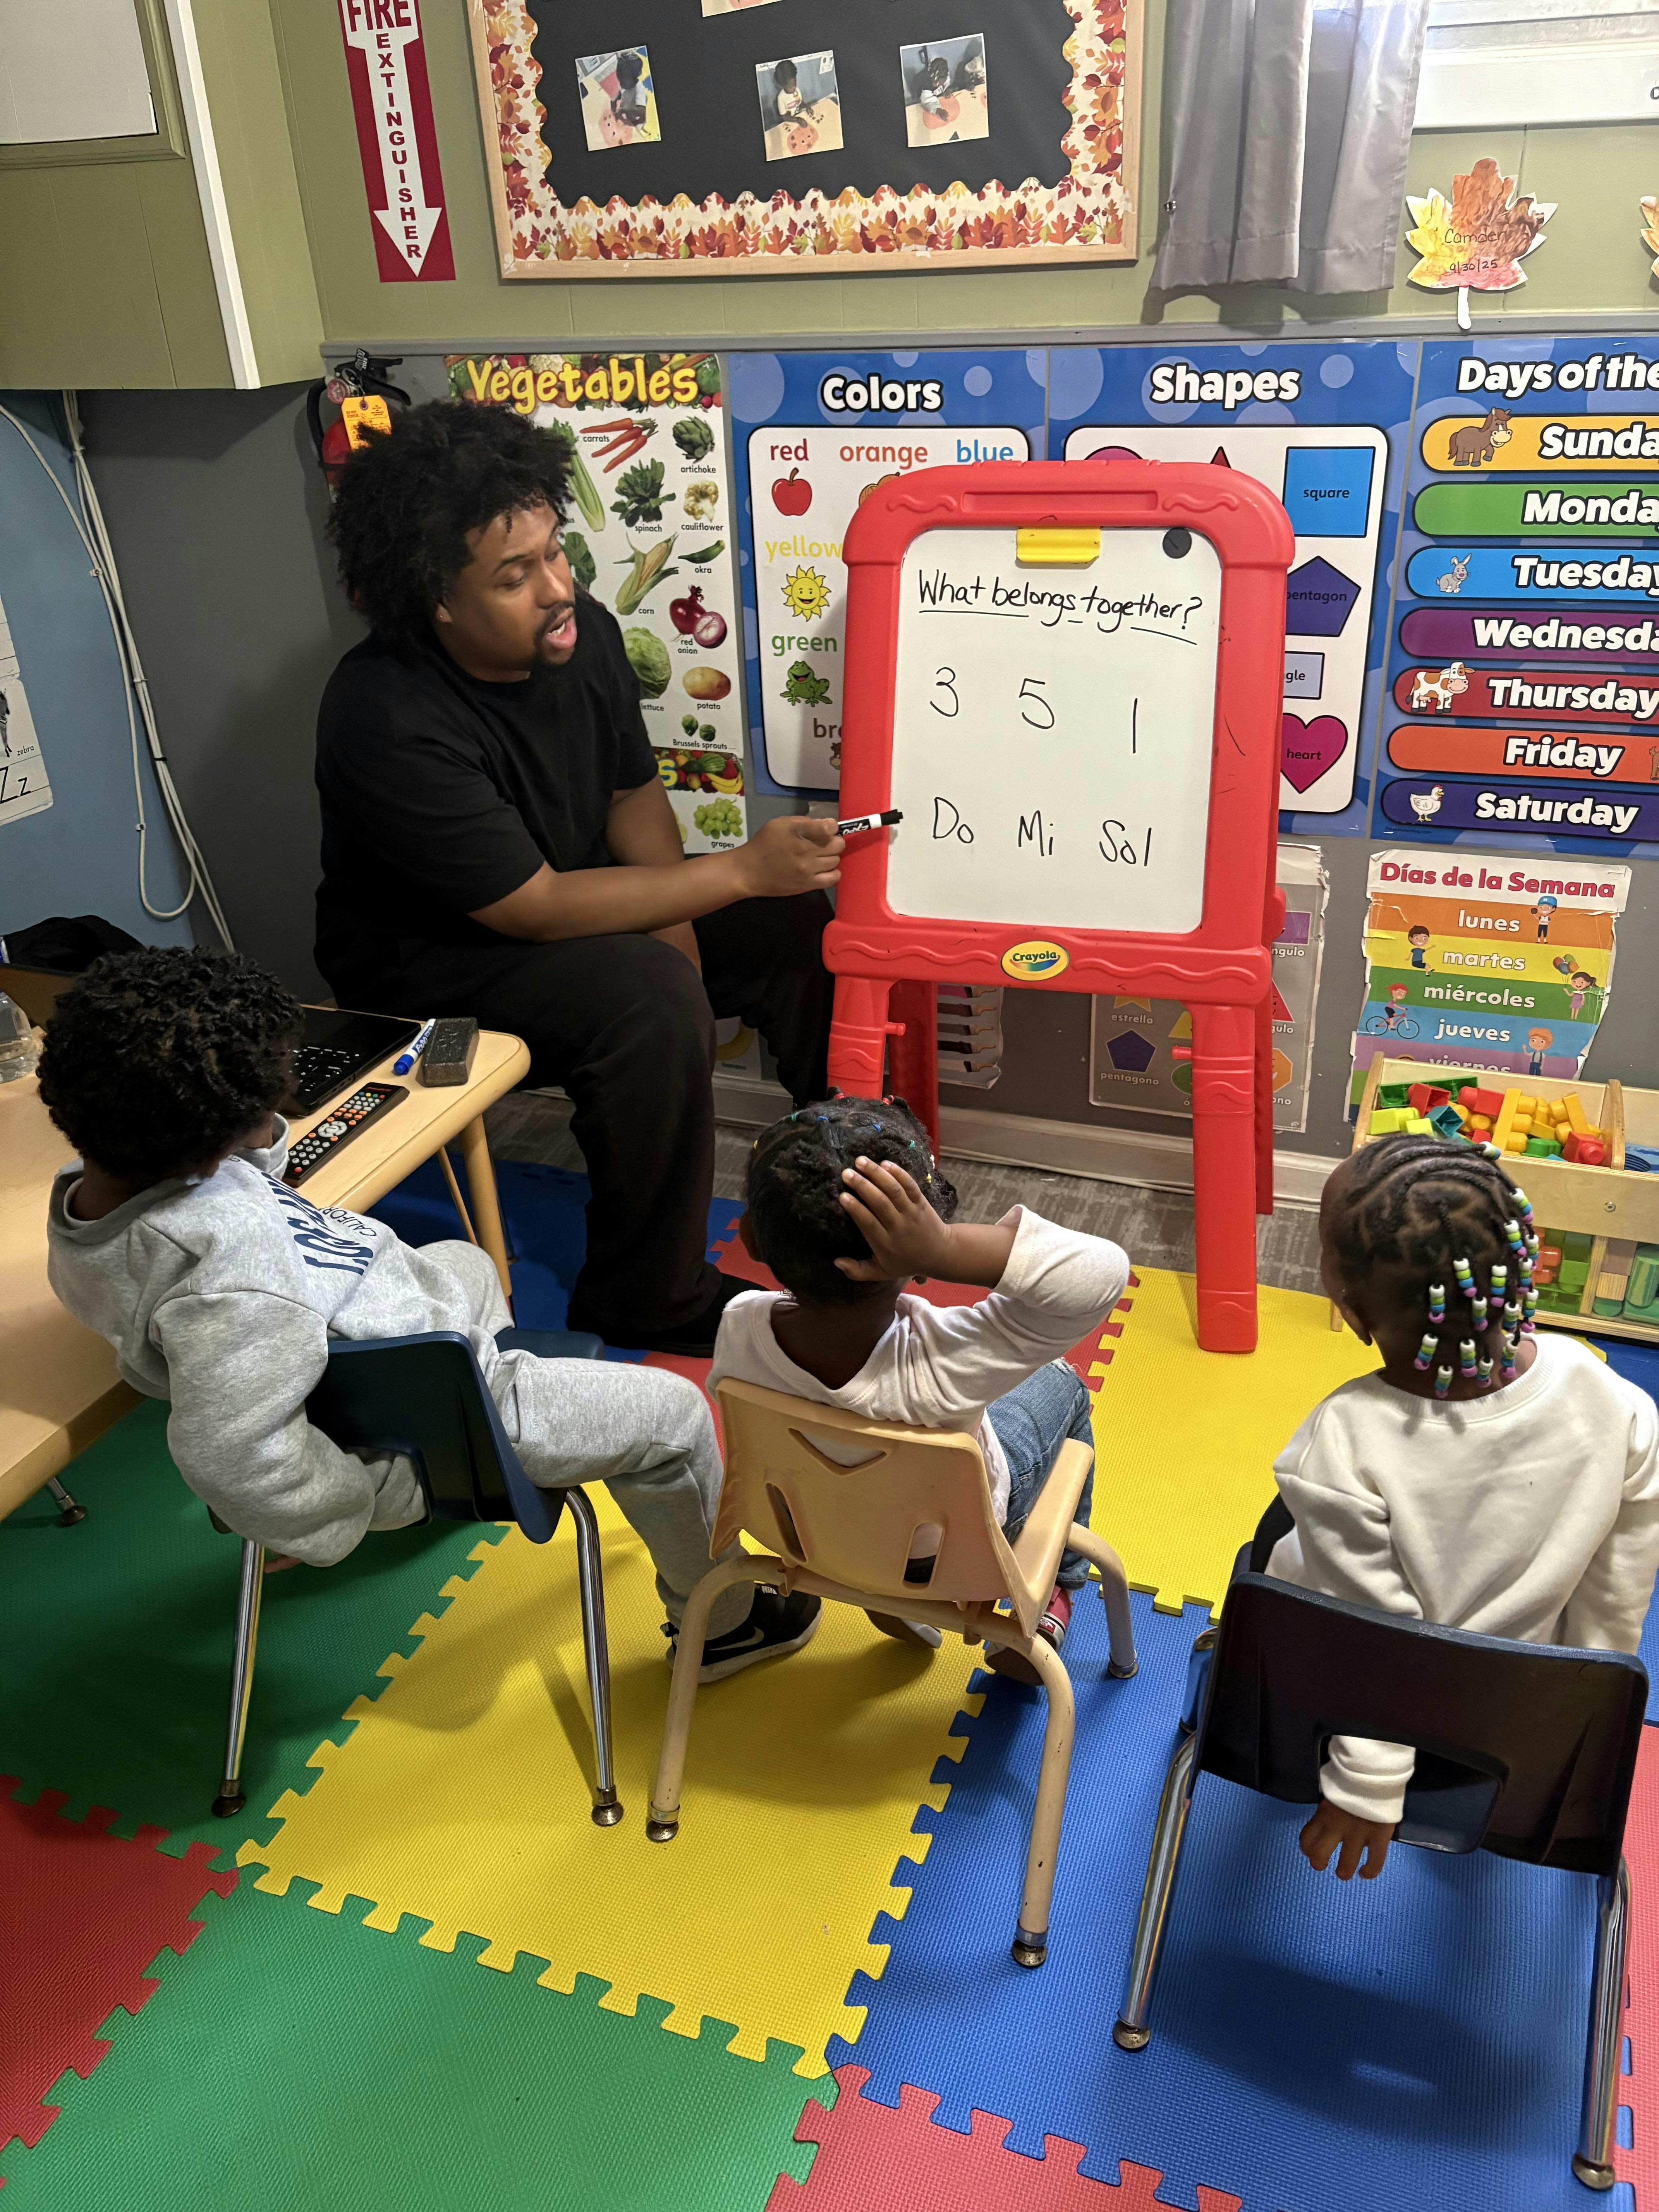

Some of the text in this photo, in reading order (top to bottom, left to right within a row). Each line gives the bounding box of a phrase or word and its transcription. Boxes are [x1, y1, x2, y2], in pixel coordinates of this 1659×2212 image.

[347, 0, 412, 32] FIRE
[376, 33, 422, 258] EXTINGUISHER
[1445, 225, 1507, 243] Camden
[1449, 259, 1498, 274] 9/30/25
[467, 357, 698, 414] Vegetables
[1151, 363, 1302, 410] Shapes
[1456, 357, 1554, 400] Days
[1557, 353, 1604, 392] of
[821, 373, 943, 412] Colors
[1538, 422, 1659, 459] Sunda
[770, 438, 1014, 470] red orange blue
[680, 465, 716, 473] artichoke
[1303, 486, 1350, 502] square
[1521, 489, 1659, 527] Monda
[635, 524, 663, 534] spinach
[681, 523, 725, 531] cauliflower
[765, 535, 843, 563] yellow
[694, 566, 712, 574] okra
[919, 569, 1202, 634] What belongs together?
[677, 647, 698, 655] onion
[771, 635, 837, 656] green
[641, 703, 665, 711] lettuce
[930, 666, 959, 717] 3
[1018, 678, 1055, 730] 5
[1487, 676, 1659, 721] Thursday
[17, 744, 34, 756] zebra
[673, 739, 700, 747] Brussels
[1286, 749, 1321, 761] heart
[1504, 735, 1625, 777] Friday
[1474, 791, 1640, 835] Saturday
[932, 796, 1152, 867] Do Mi Sol
[711, 840, 735, 849] grapes
[1380, 863, 1615, 898] Días de la Semana
[1457, 908, 1520, 932] lunes
[1012, 950, 1056, 962] Crayola
[1443, 950, 1526, 971] martes
[1423, 983, 1536, 1008] miércoles
[1111, 1014, 1153, 1024] estrella
[1434, 1018, 1511, 1042] jueves
[1101, 1073, 1159, 1085] pentágono
